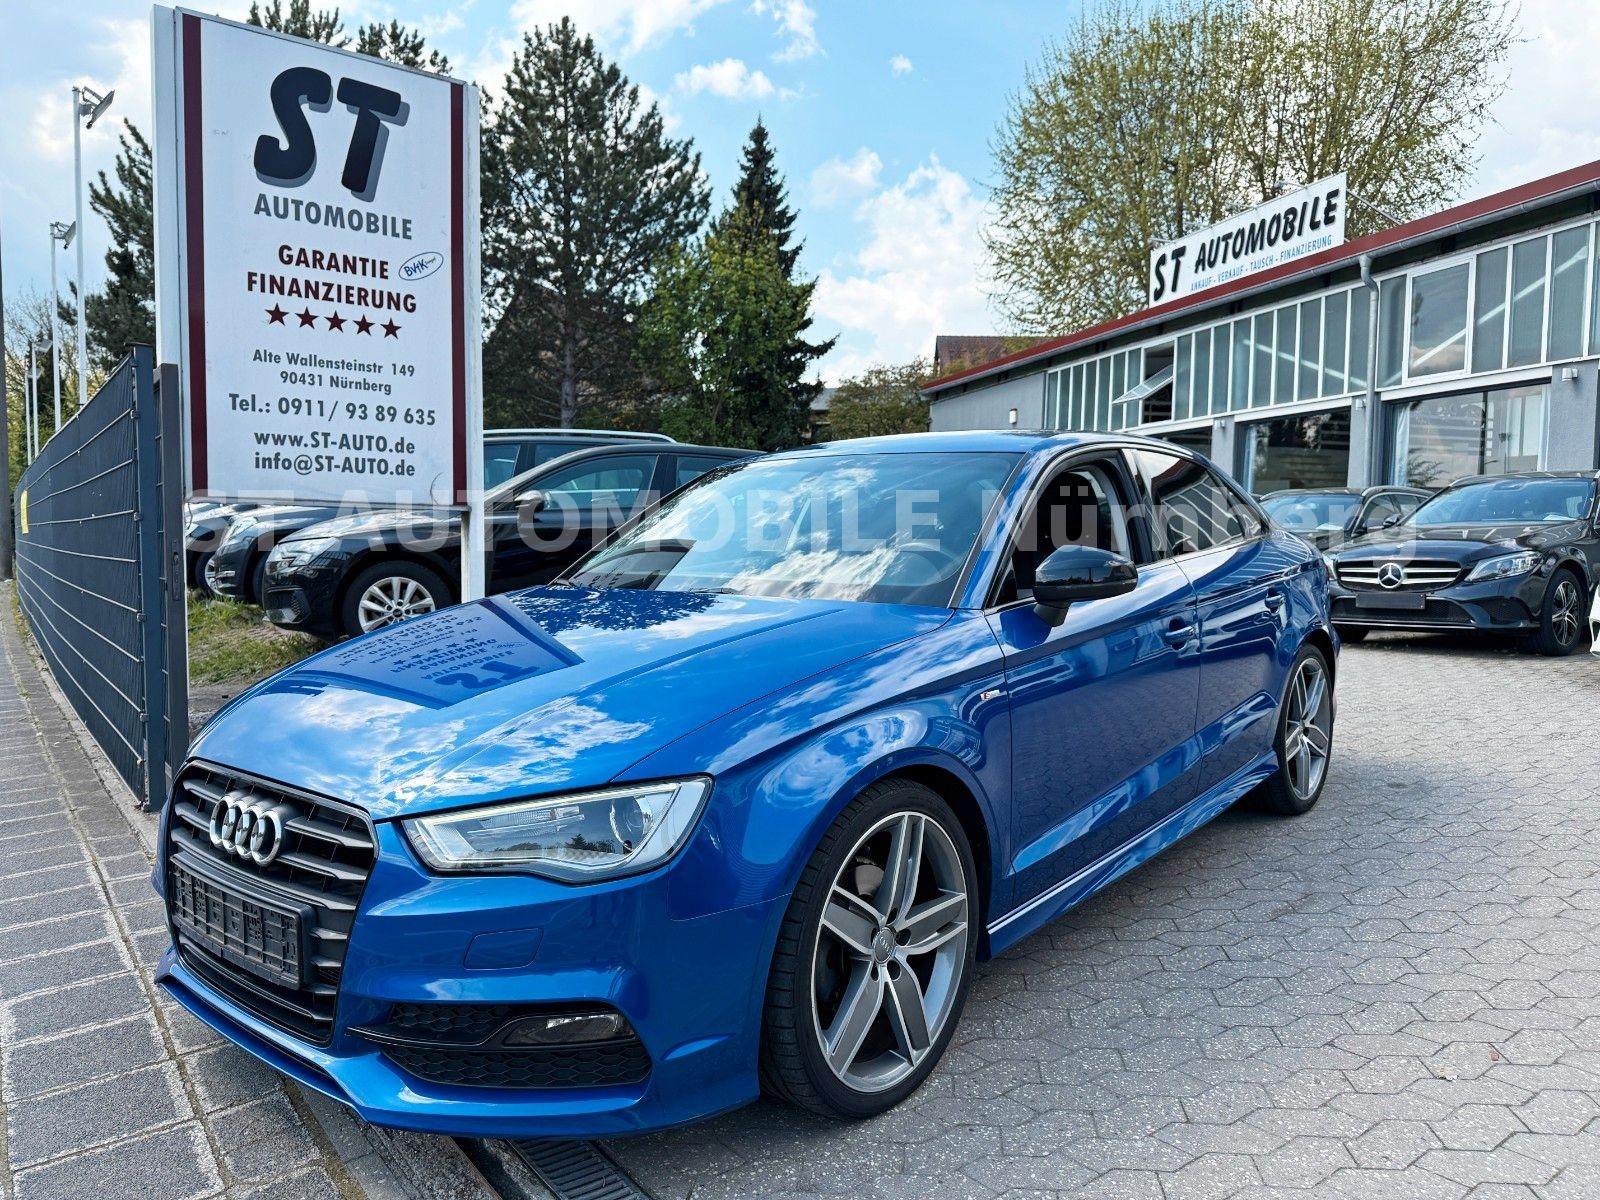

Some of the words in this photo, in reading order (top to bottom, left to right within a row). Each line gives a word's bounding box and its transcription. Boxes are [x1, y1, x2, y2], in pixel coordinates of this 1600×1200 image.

[253, 66, 411, 203] ST
[254, 193, 413, 240] AUTOMOBILE
[278, 244, 389, 280] GARANTIE
[1153, 246, 1187, 301] ST
[1194, 189, 1340, 274] AUTOMOBILE
[1191, 276, 1212, 291] ANKAUF
[1217, 265, 1244, 283] VERKAUF
[1250, 255, 1274, 270] TAUSCH
[1280, 234, 1332, 262] FINANZIERUNG
[247, 271, 417, 313] FINANZIERUNG
[253, 349, 281, 364] Alte
[286, 352, 383, 374] Wallensteinstr
[391, 363, 415, 377] 149
[280, 371, 323, 386] 90431
[329, 374, 392, 395] Nürnberg
[229, 393, 271, 413] Tel.:
[345, 403, 368, 421] 93
[375, 406, 397, 422] 89
[403, 407, 436, 426] 635
[254, 432, 415, 454] www.ST-AUTO.de
[254, 452, 415, 476] info@ST-AUTO.de
